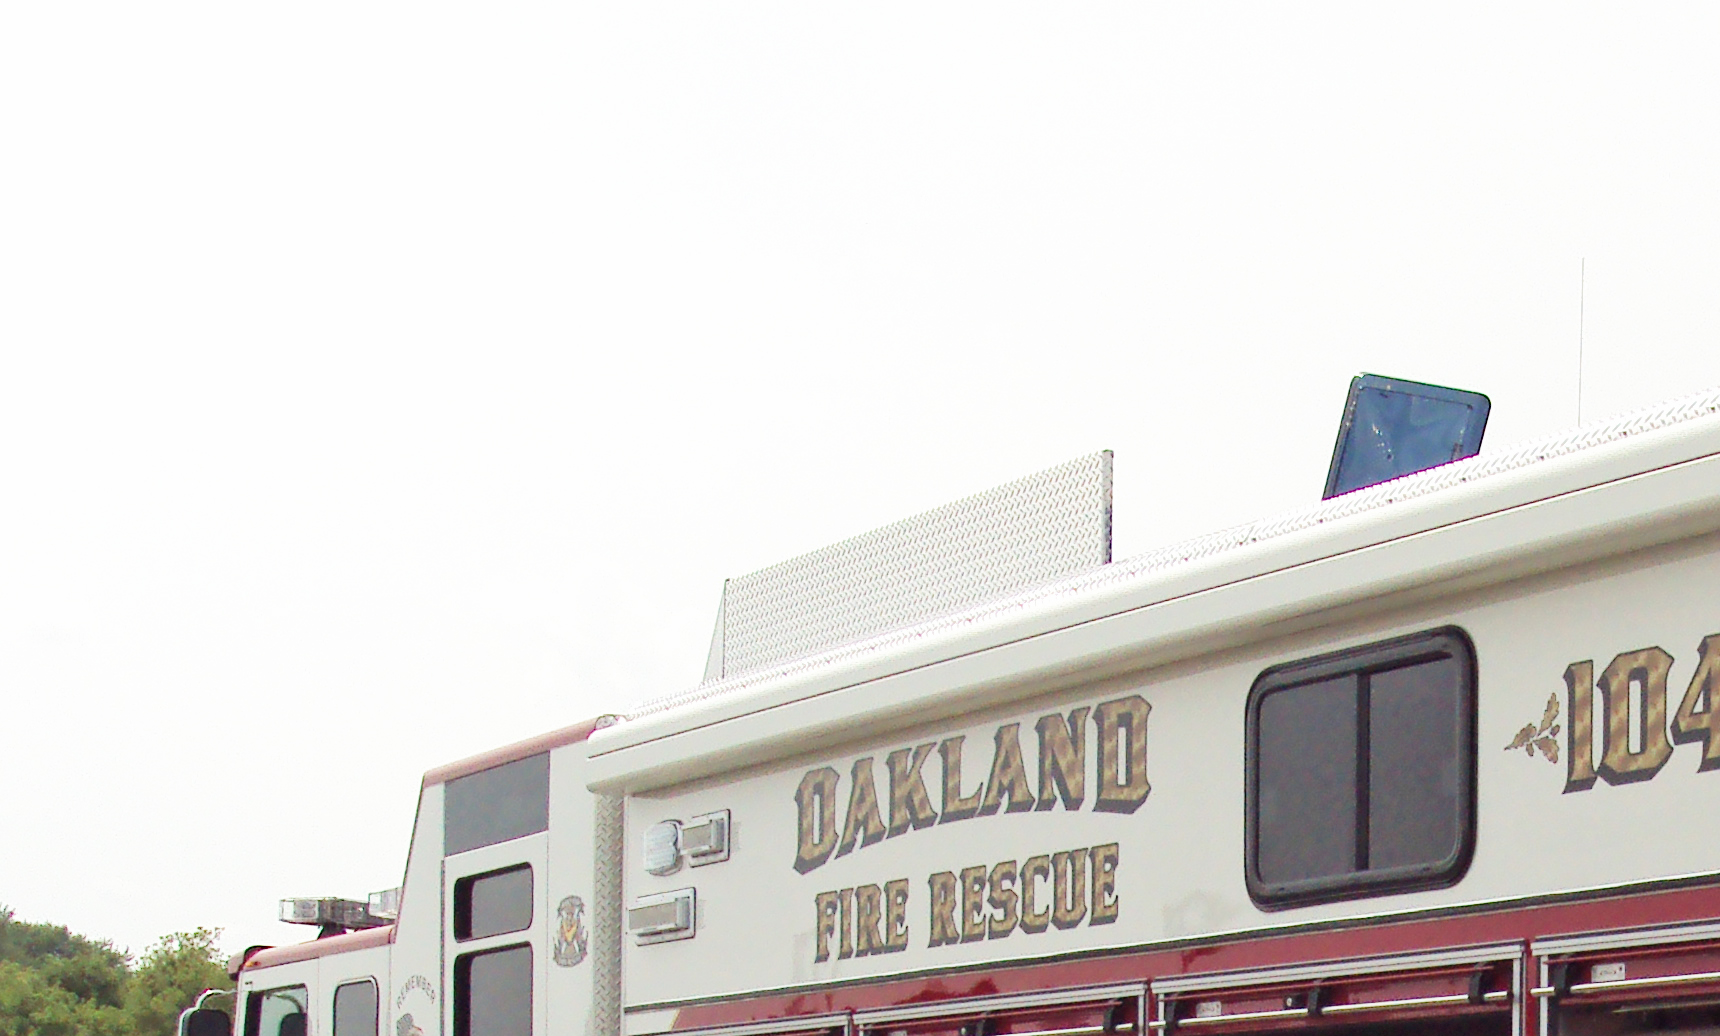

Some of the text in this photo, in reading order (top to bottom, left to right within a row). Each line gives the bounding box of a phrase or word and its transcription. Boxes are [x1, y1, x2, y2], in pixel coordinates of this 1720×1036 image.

[793, 695, 1152, 875] OAKLAND
[814, 841, 1119, 963] FIRE RESCUE
[397, 975, 436, 1009] REMEMBER
